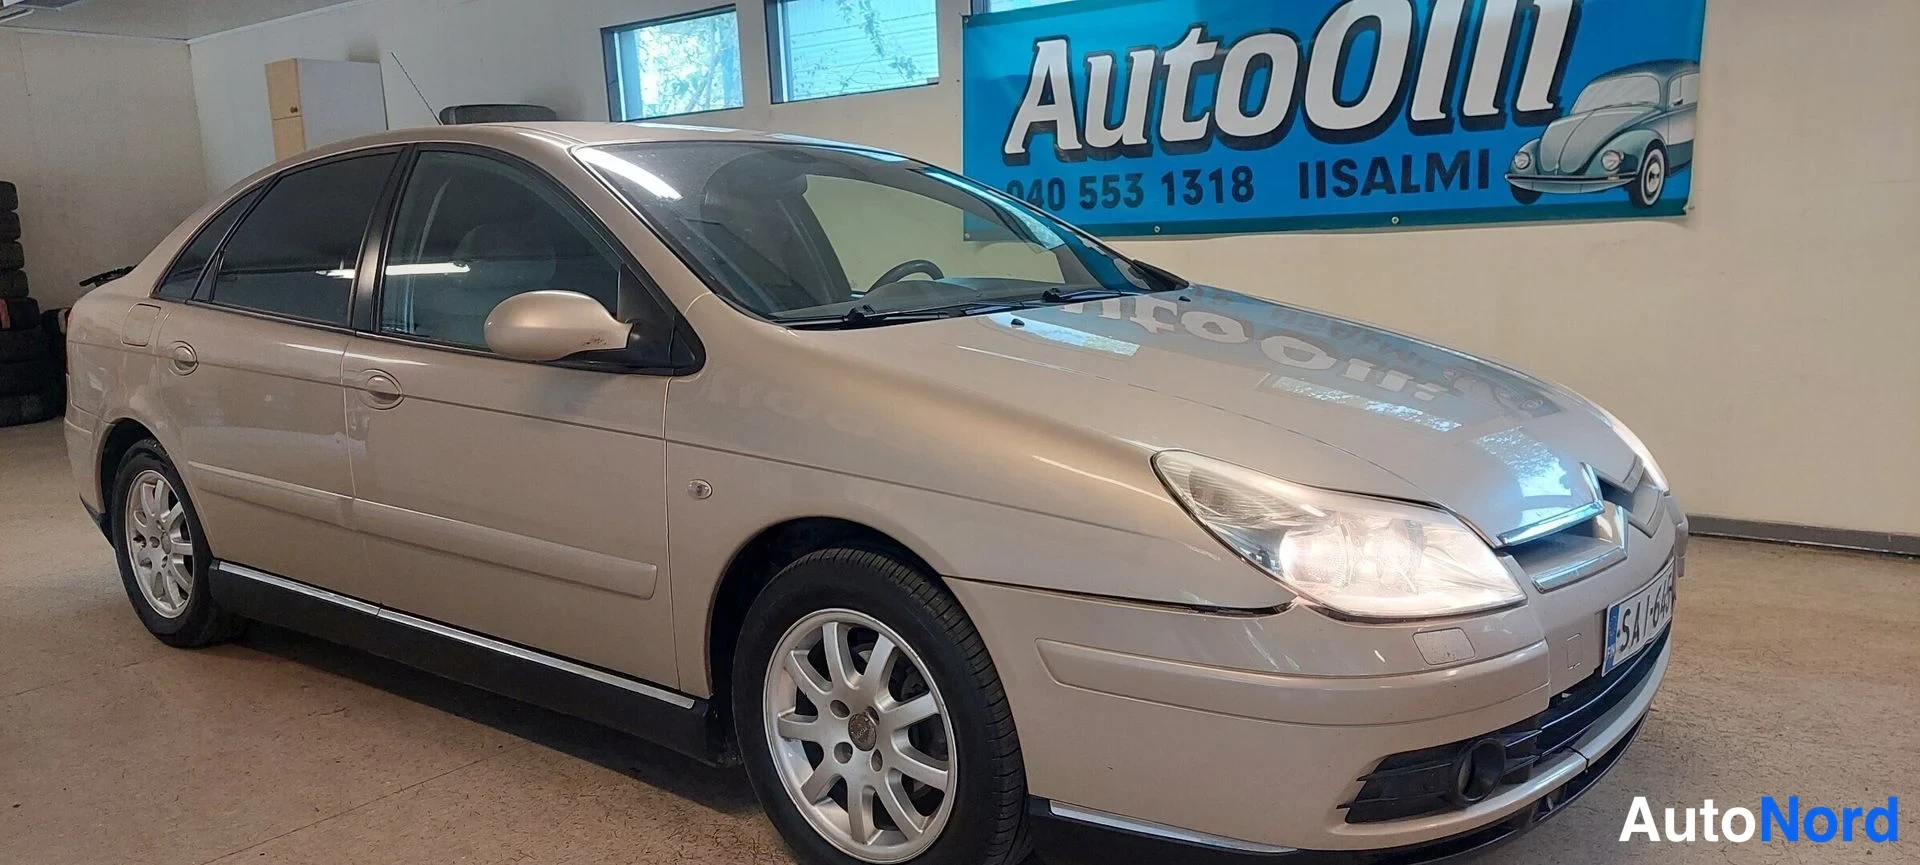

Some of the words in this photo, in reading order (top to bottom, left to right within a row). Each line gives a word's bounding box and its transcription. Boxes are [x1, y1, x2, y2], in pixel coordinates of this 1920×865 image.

[1003, 0, 1576, 156] AutoOlli
[1006, 176, 1066, 211] 040
[1079, 172, 1145, 210] 553
[1161, 165, 1255, 206] 1318
[1298, 148, 1490, 200] IISALMI
